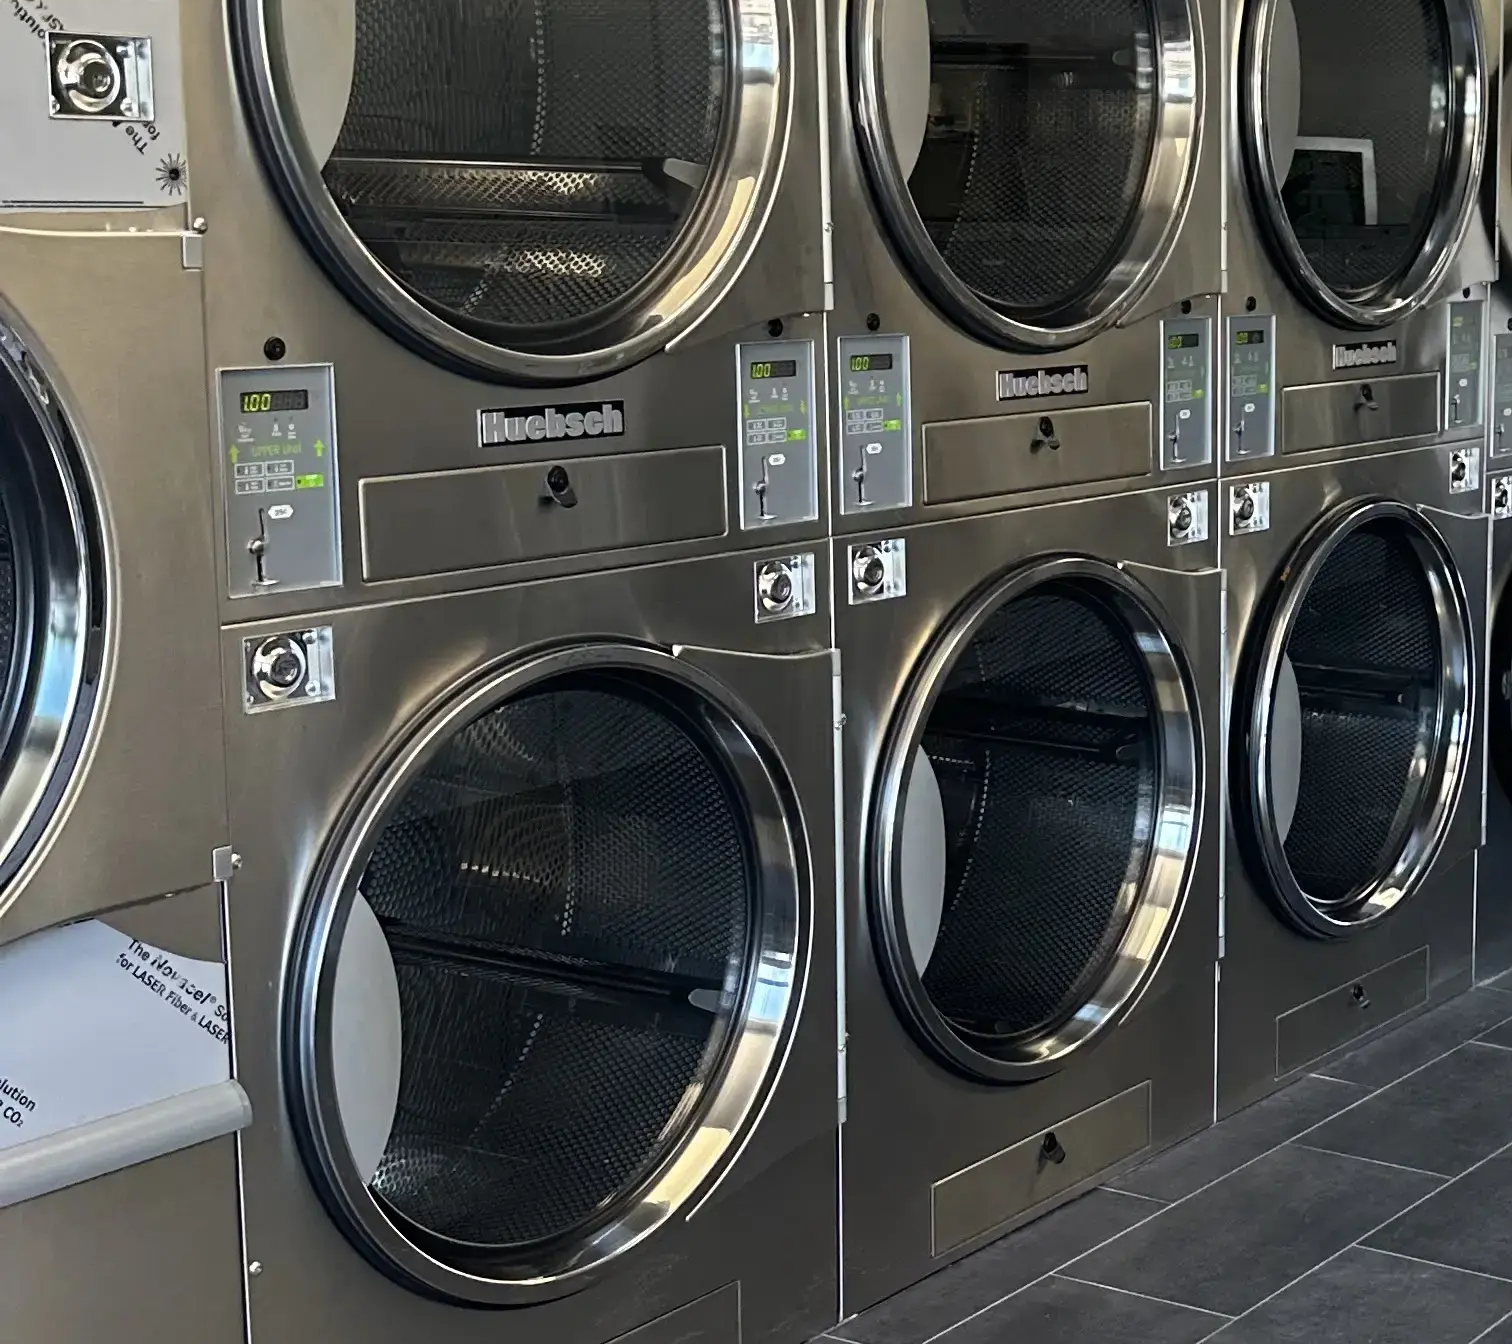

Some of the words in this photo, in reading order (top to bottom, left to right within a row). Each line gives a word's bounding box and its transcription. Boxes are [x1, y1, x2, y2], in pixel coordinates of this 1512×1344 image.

[999, 366, 1088, 399] Huebsch
[482, 403, 624, 444] Huebsch
[128, 938, 151, 961] The
[116, 952, 135, 971] for
[131, 965, 167, 998] LASER
[165, 990, 193, 1016] Fiber
[0, 1078, 36, 1112] lution
